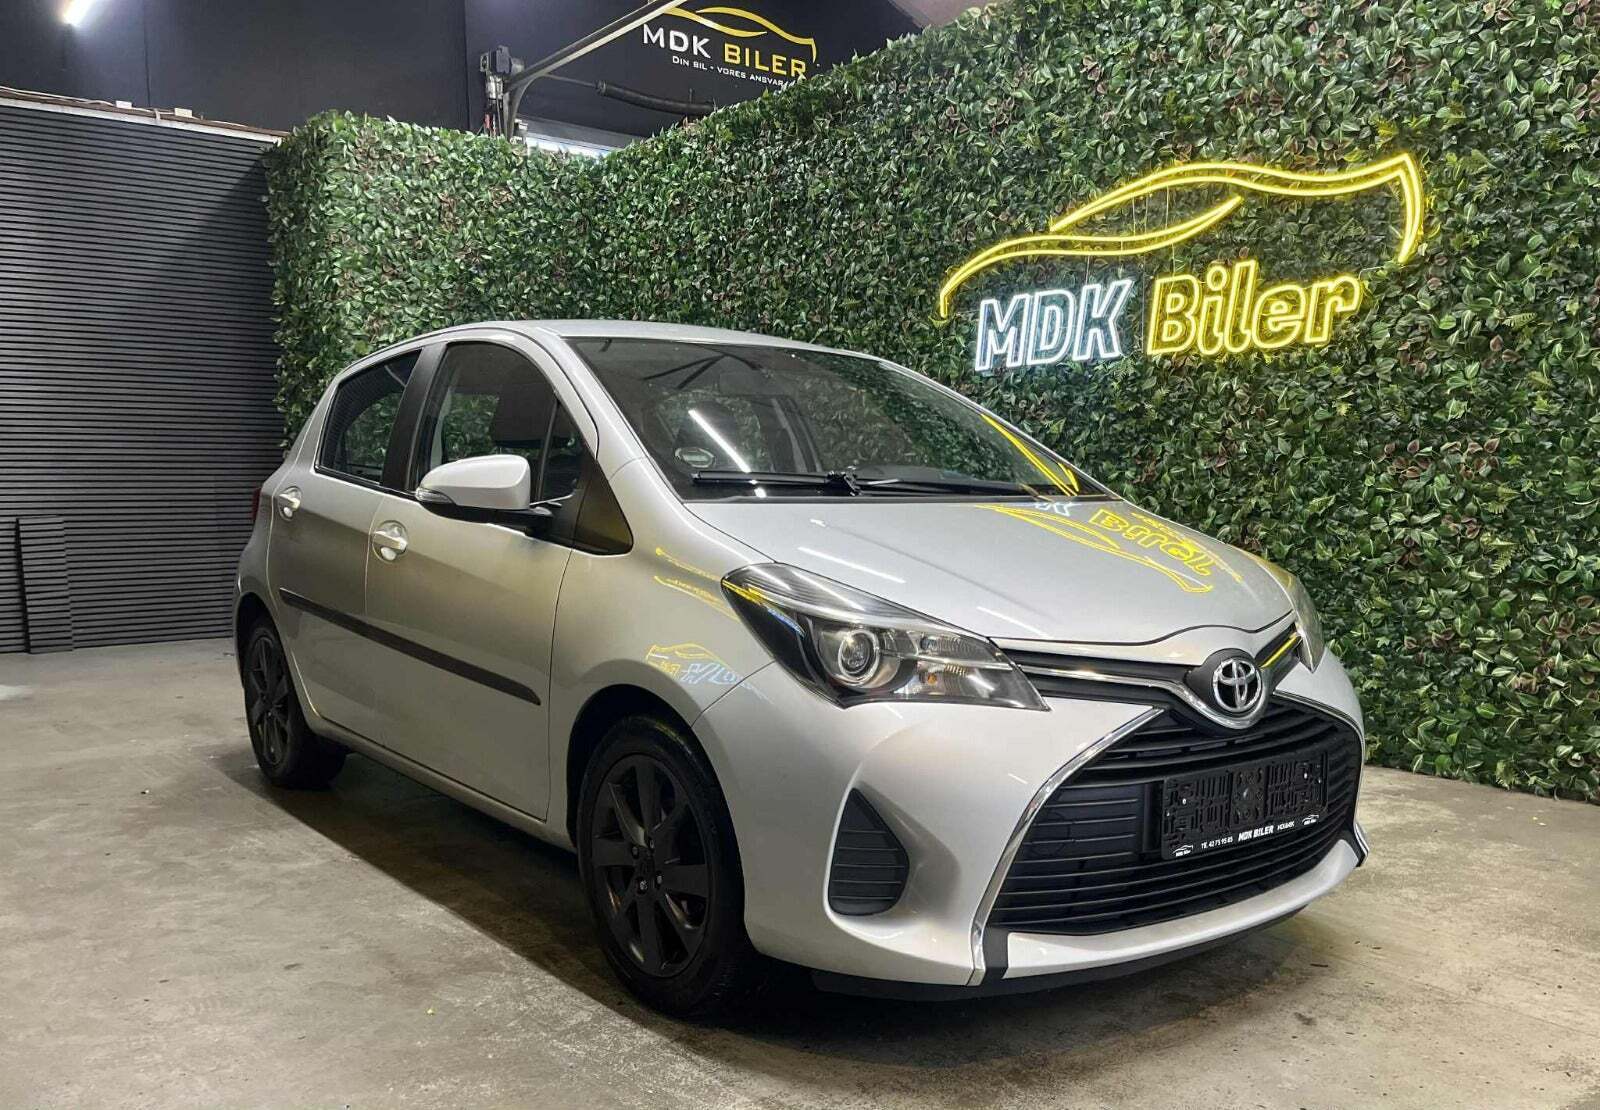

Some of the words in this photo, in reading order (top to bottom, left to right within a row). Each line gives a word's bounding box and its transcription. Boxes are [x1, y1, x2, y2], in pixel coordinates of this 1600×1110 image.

[643, 24, 711, 58] MDK
[724, 42, 806, 80] BILER
[717, 66, 746, 79] VORES
[974, 277, 1135, 372] MDK
[1147, 259, 1362, 356] Biler
[1237, 830, 1253, 842] MDK
[1253, 825, 1274, 838] BILER
